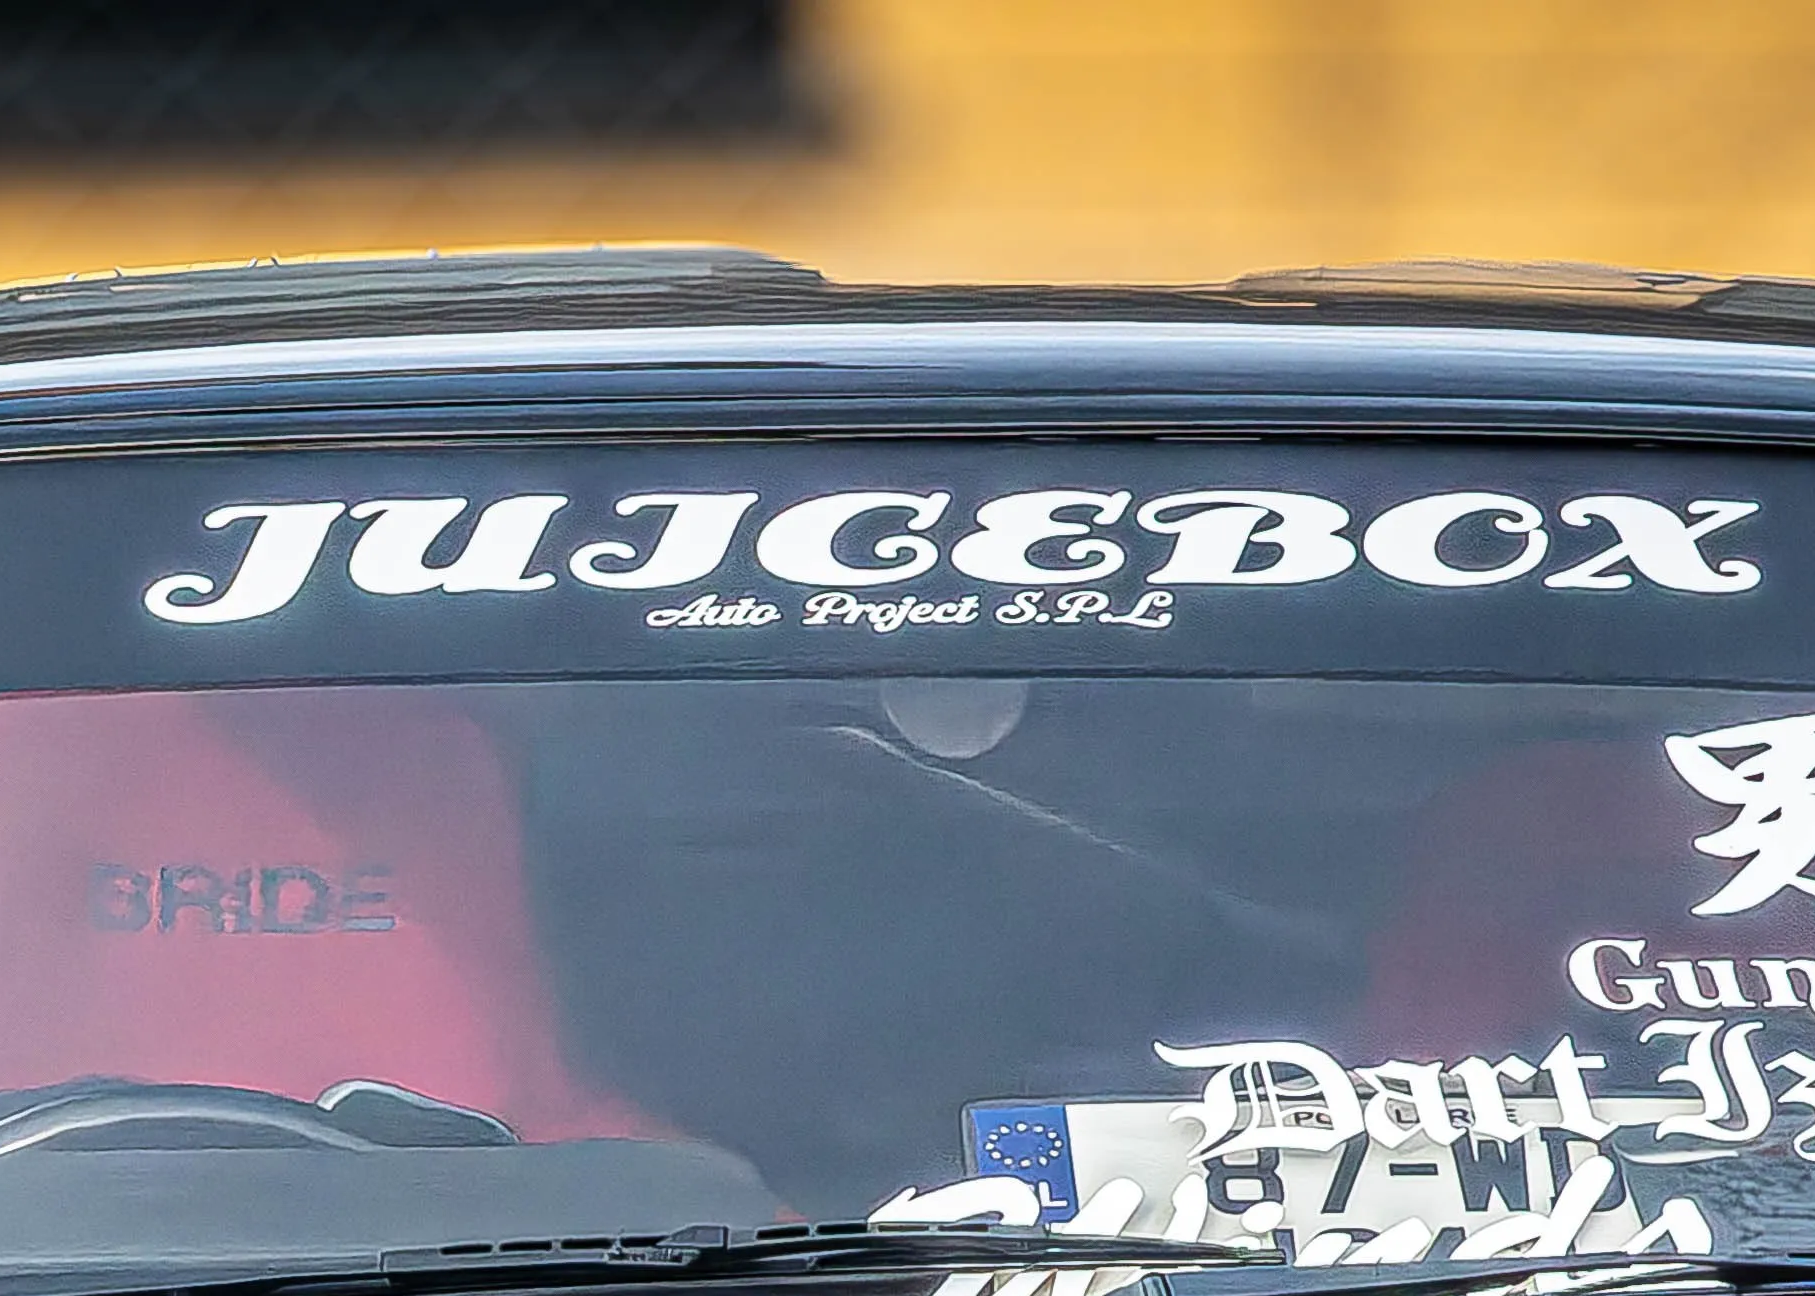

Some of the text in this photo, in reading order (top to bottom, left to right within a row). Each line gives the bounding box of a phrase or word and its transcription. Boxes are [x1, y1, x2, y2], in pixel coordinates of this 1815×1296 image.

[144, 489, 1764, 624] JUICEBOX
[645, 593, 783, 630] Auto
[802, 591, 982, 634] Project
[89, 861, 398, 935] BRIDE
[1153, 1033, 1608, 1168] Dart
